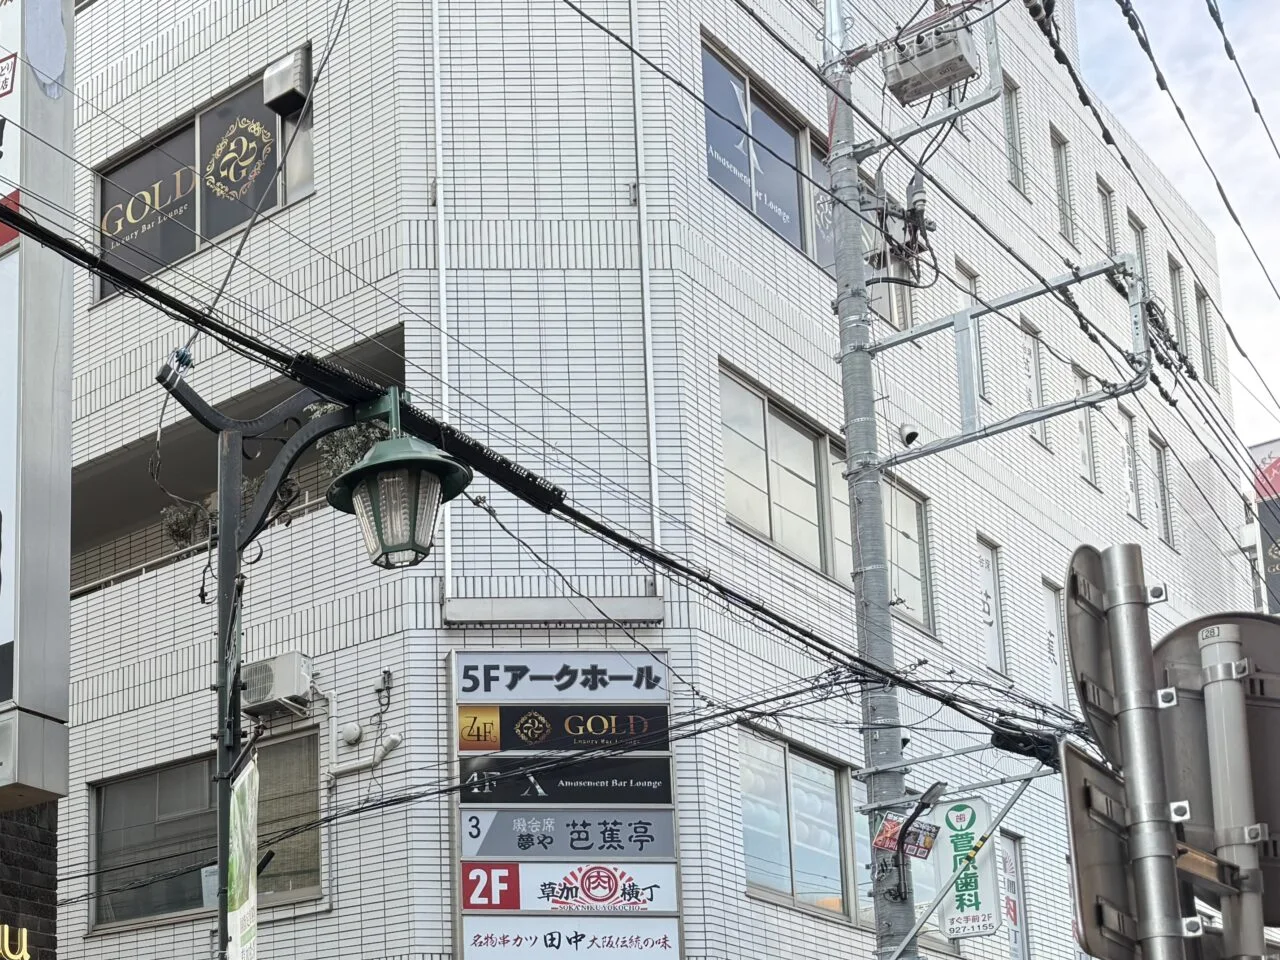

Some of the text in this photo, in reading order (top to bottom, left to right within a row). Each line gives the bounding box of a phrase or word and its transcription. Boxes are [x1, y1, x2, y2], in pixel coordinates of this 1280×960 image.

[102, 165, 196, 238] GOLD
[141, 219, 155, 234] Bar
[1204, 628, 1216, 638] 28
[563, 714, 649, 736] GOLD
[557, 778, 662, 788] Amusement Bar Lounge
[468, 816, 481, 839] 3
[565, 819, 655, 851] 芭蕉亭
[516, 833, 554, 850] 夢や
[949, 832, 981, 913] 菅原歯科
[468, 868, 509, 905] 2F
[949, 923, 995, 934] 927-1155
[543, 930, 587, 951] 田中
[586, 934, 672, 950] 大阪伝統の味
